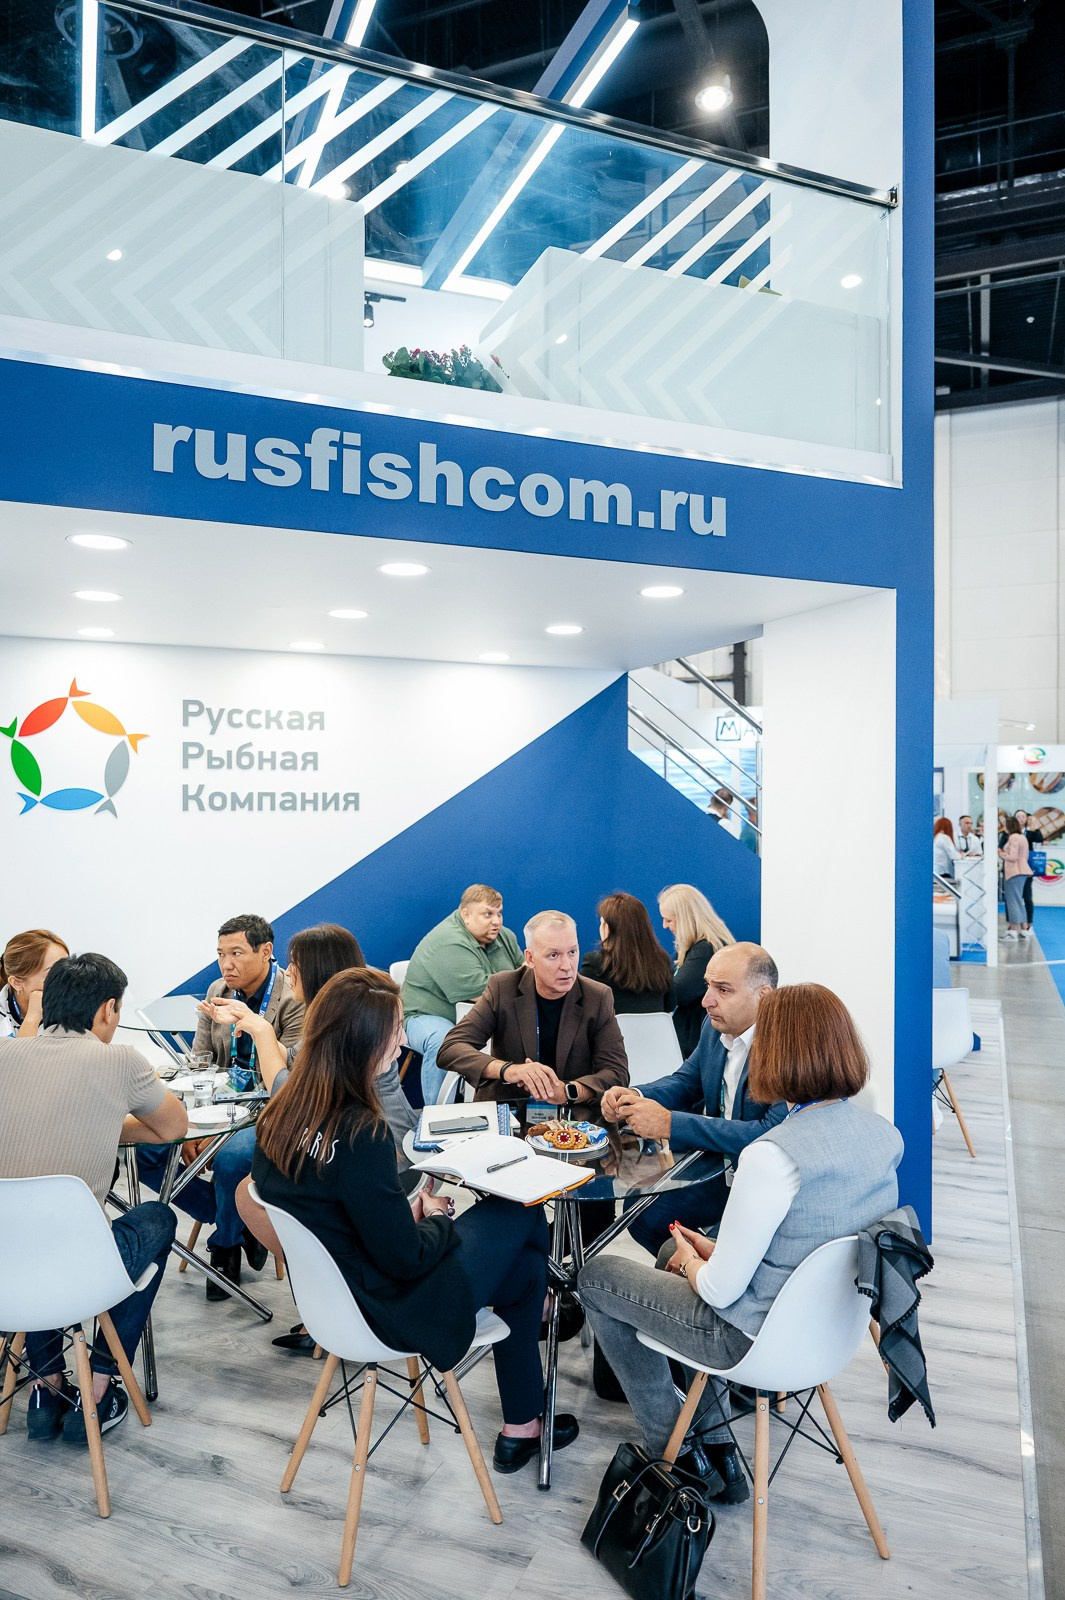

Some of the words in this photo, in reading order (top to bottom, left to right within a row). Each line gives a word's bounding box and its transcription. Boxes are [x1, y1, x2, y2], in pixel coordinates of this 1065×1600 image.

[153, 421, 727, 537] rusfishcom.ru
[181, 698, 326, 735] Русская
[181, 740, 320, 772] Рыбная
[181, 783, 361, 812] Компания
